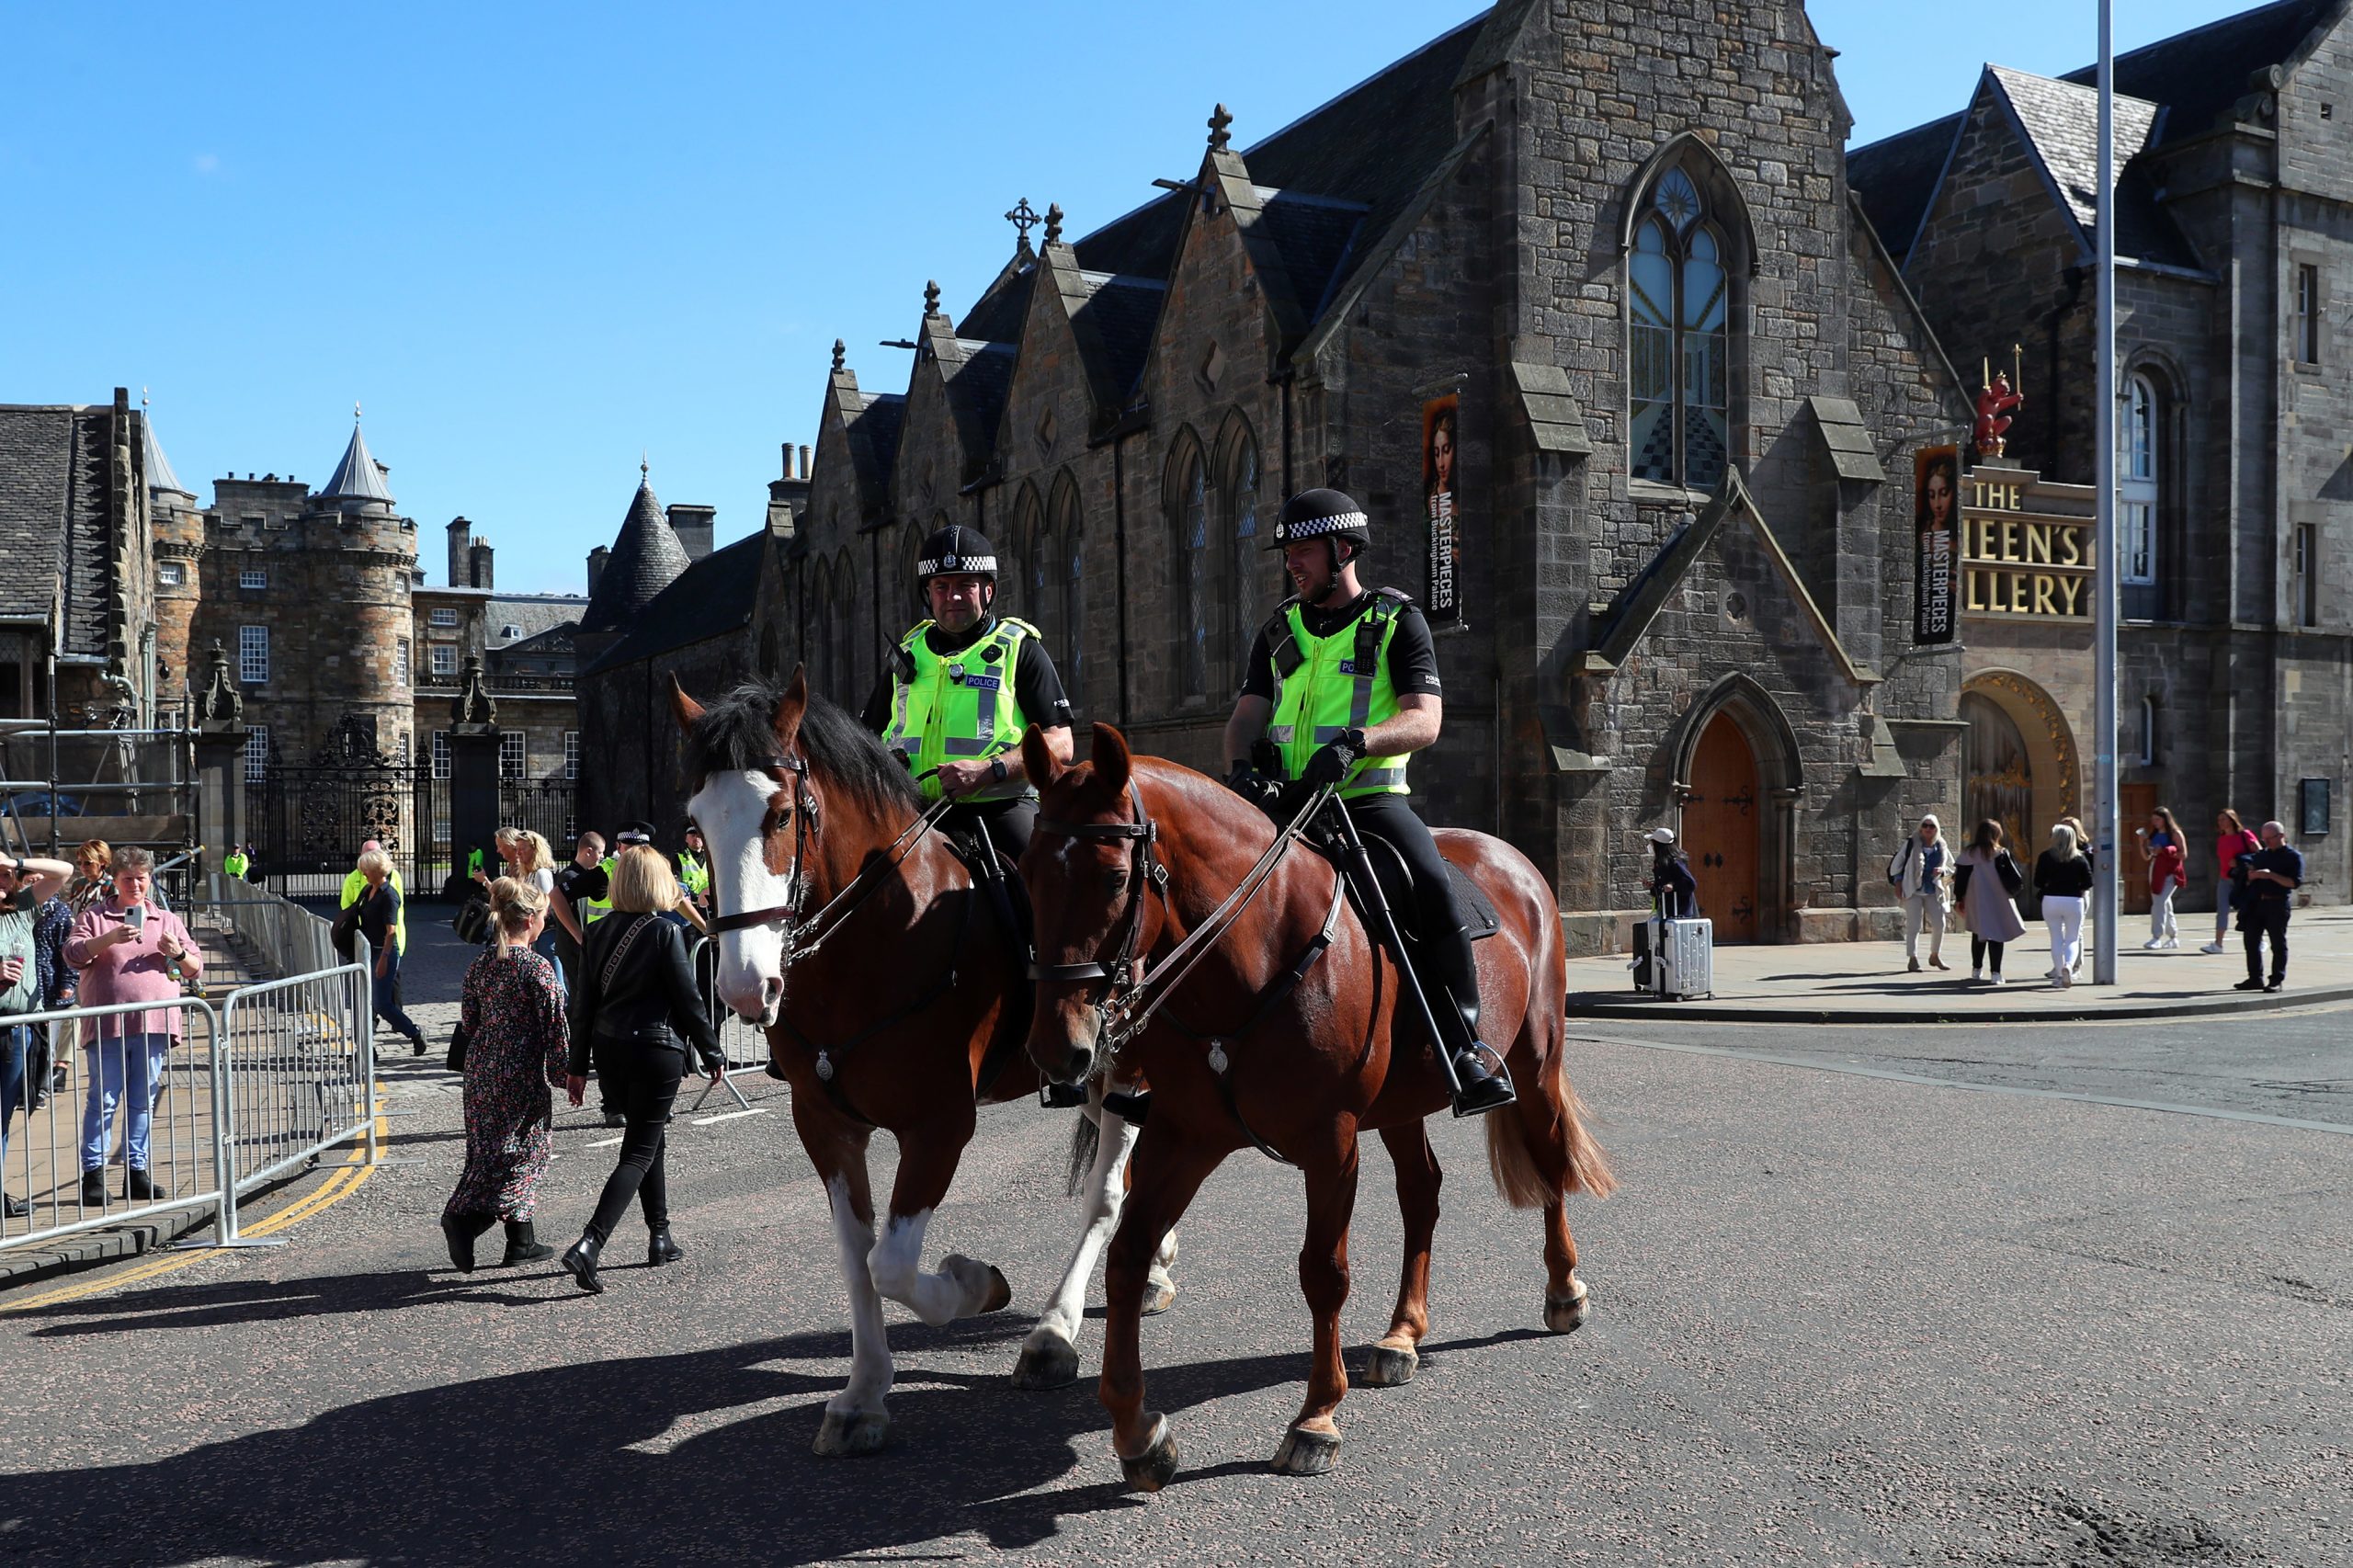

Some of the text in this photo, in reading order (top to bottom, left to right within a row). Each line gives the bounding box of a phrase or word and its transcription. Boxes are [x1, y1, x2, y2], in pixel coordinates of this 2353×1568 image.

[1974, 482, 2020, 510] THE
[1430, 494, 1439, 610] from Buckingham Palace
[1438, 491, 1452, 608] MASTERPIECES
[1962, 518, 2080, 565] EEN'S
[1921, 531, 1932, 634] from Buckingham Palace
[1931, 529, 1949, 633] MASTERPIECES
[1968, 571, 2083, 615] LLERY
[968, 676, 998, 687] POLICE
